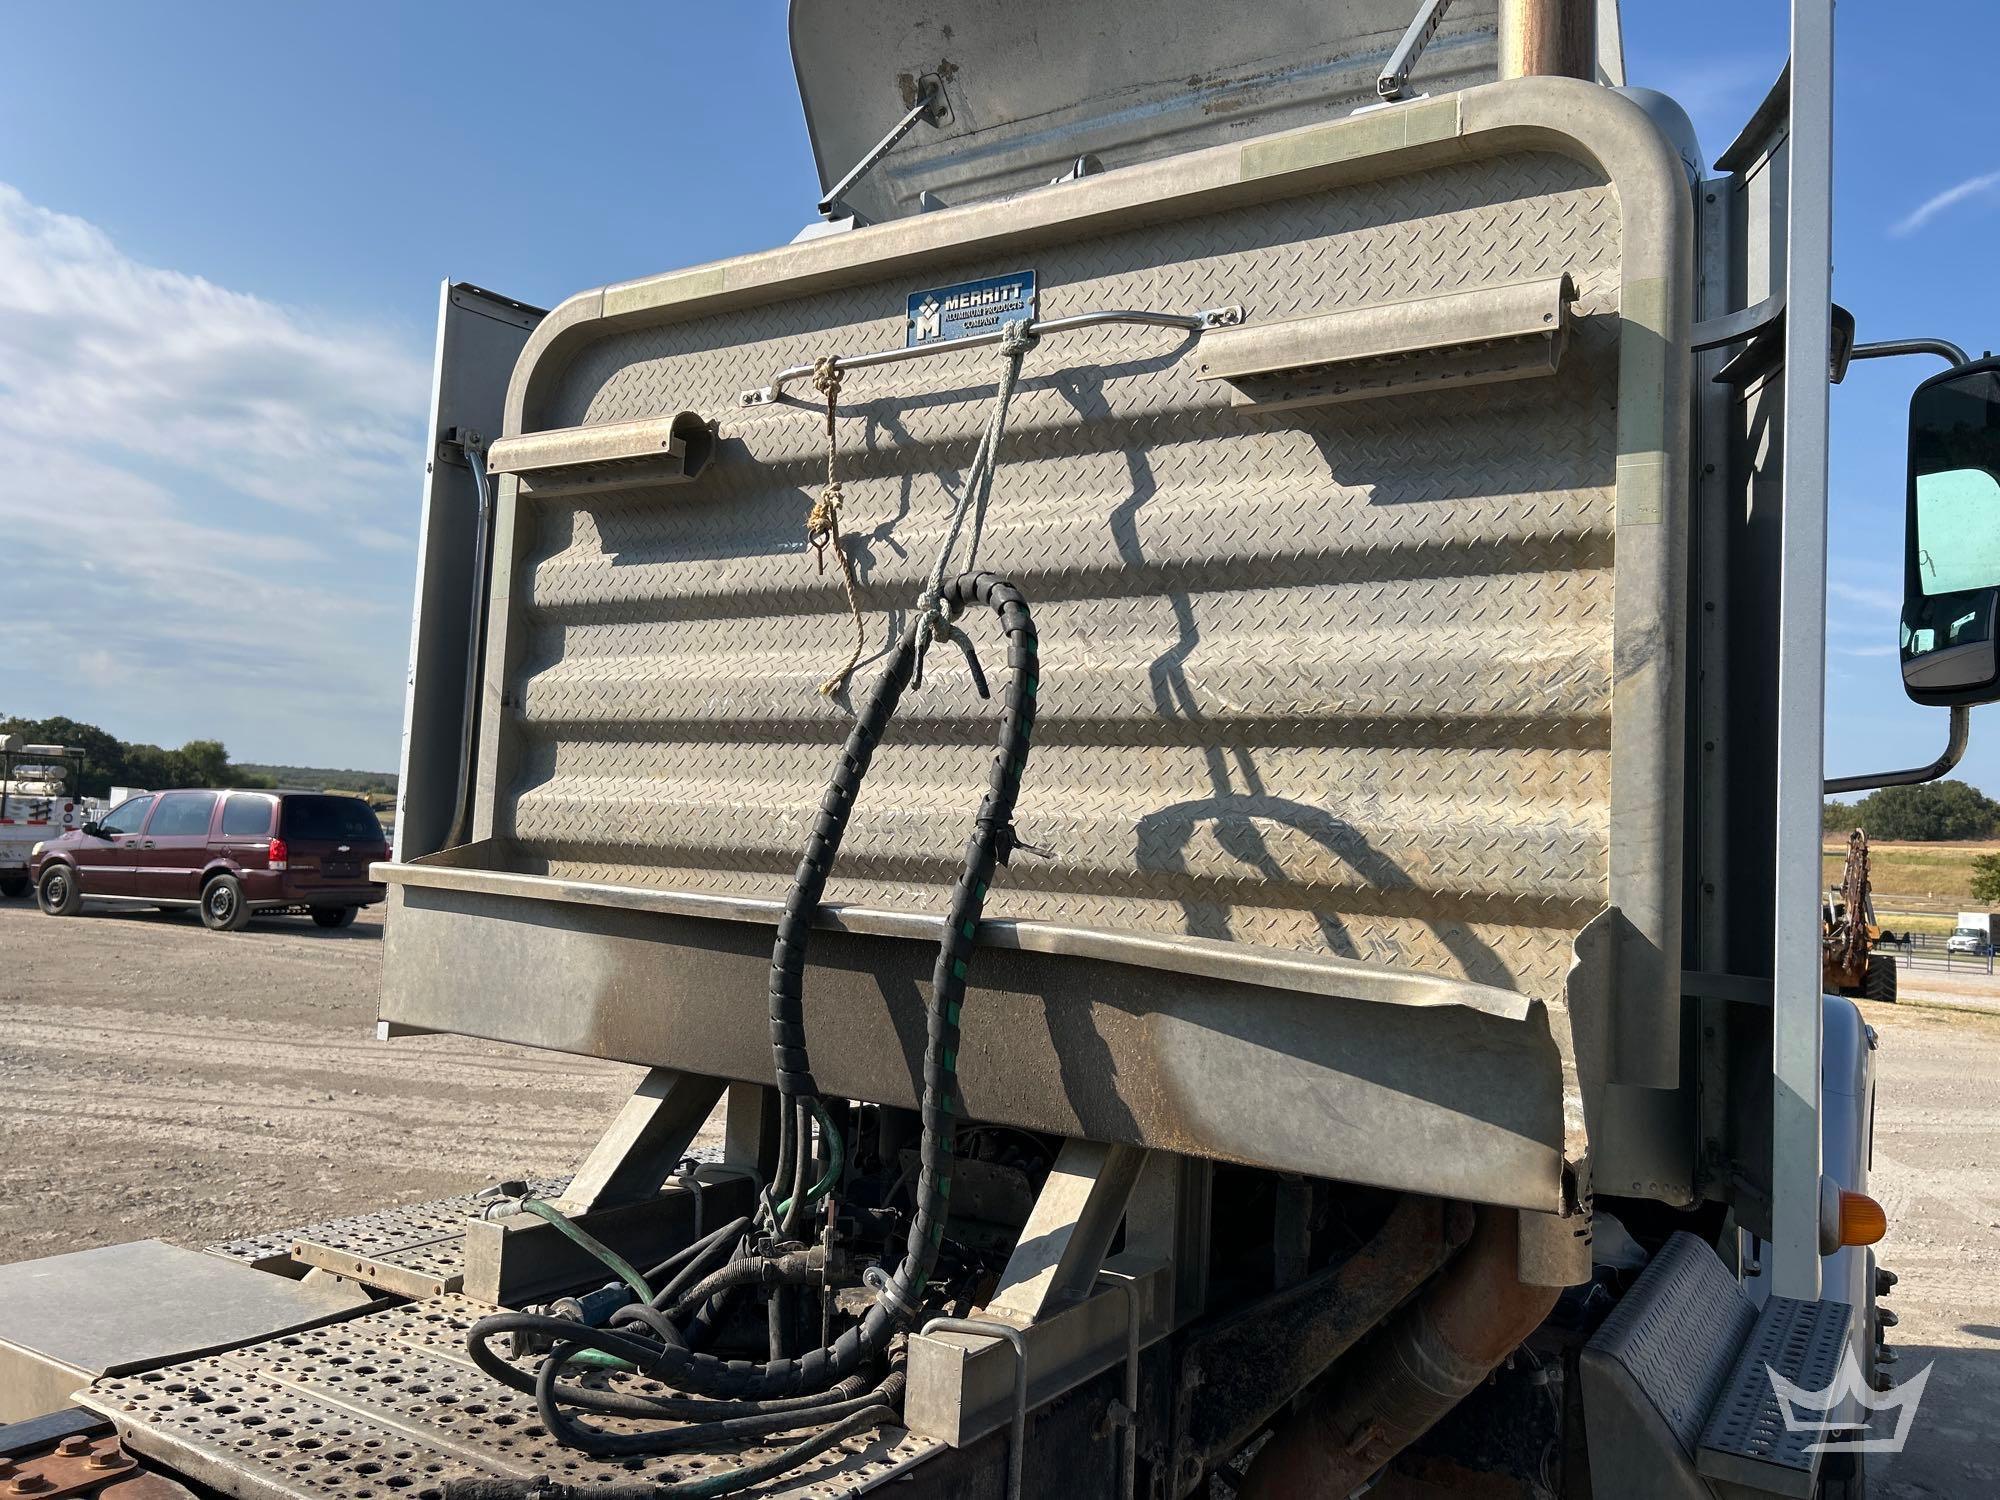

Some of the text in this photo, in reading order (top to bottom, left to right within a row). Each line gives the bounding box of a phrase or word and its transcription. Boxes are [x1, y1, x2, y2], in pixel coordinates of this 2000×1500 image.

[945, 284, 1022, 310] MERRITT
[945, 301, 1024, 322] ALUMINUM PRODUCTS
[963, 316, 999, 329] COMPANY
